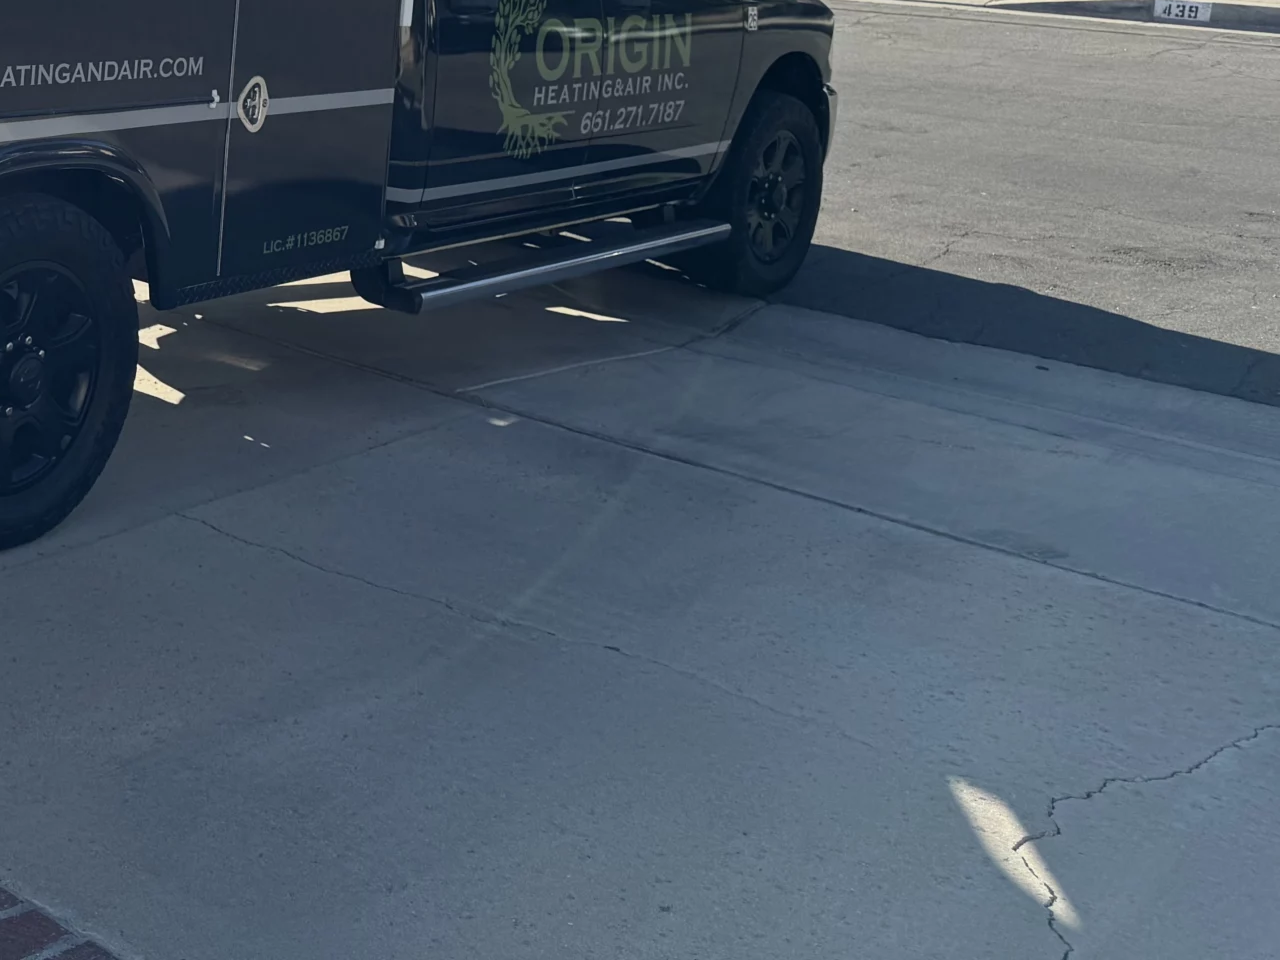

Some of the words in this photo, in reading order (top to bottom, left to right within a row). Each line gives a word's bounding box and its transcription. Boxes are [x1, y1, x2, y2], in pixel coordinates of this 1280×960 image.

[1162, 3, 1199, 19] 439
[535, 12, 693, 82] ORIGIN
[533, 75, 652, 107] HEATING&AIR
[657, 72, 689, 92] INC.
[580, 100, 685, 135] 661.271.7187
[263, 225, 349, 254] LIC.#1136867
